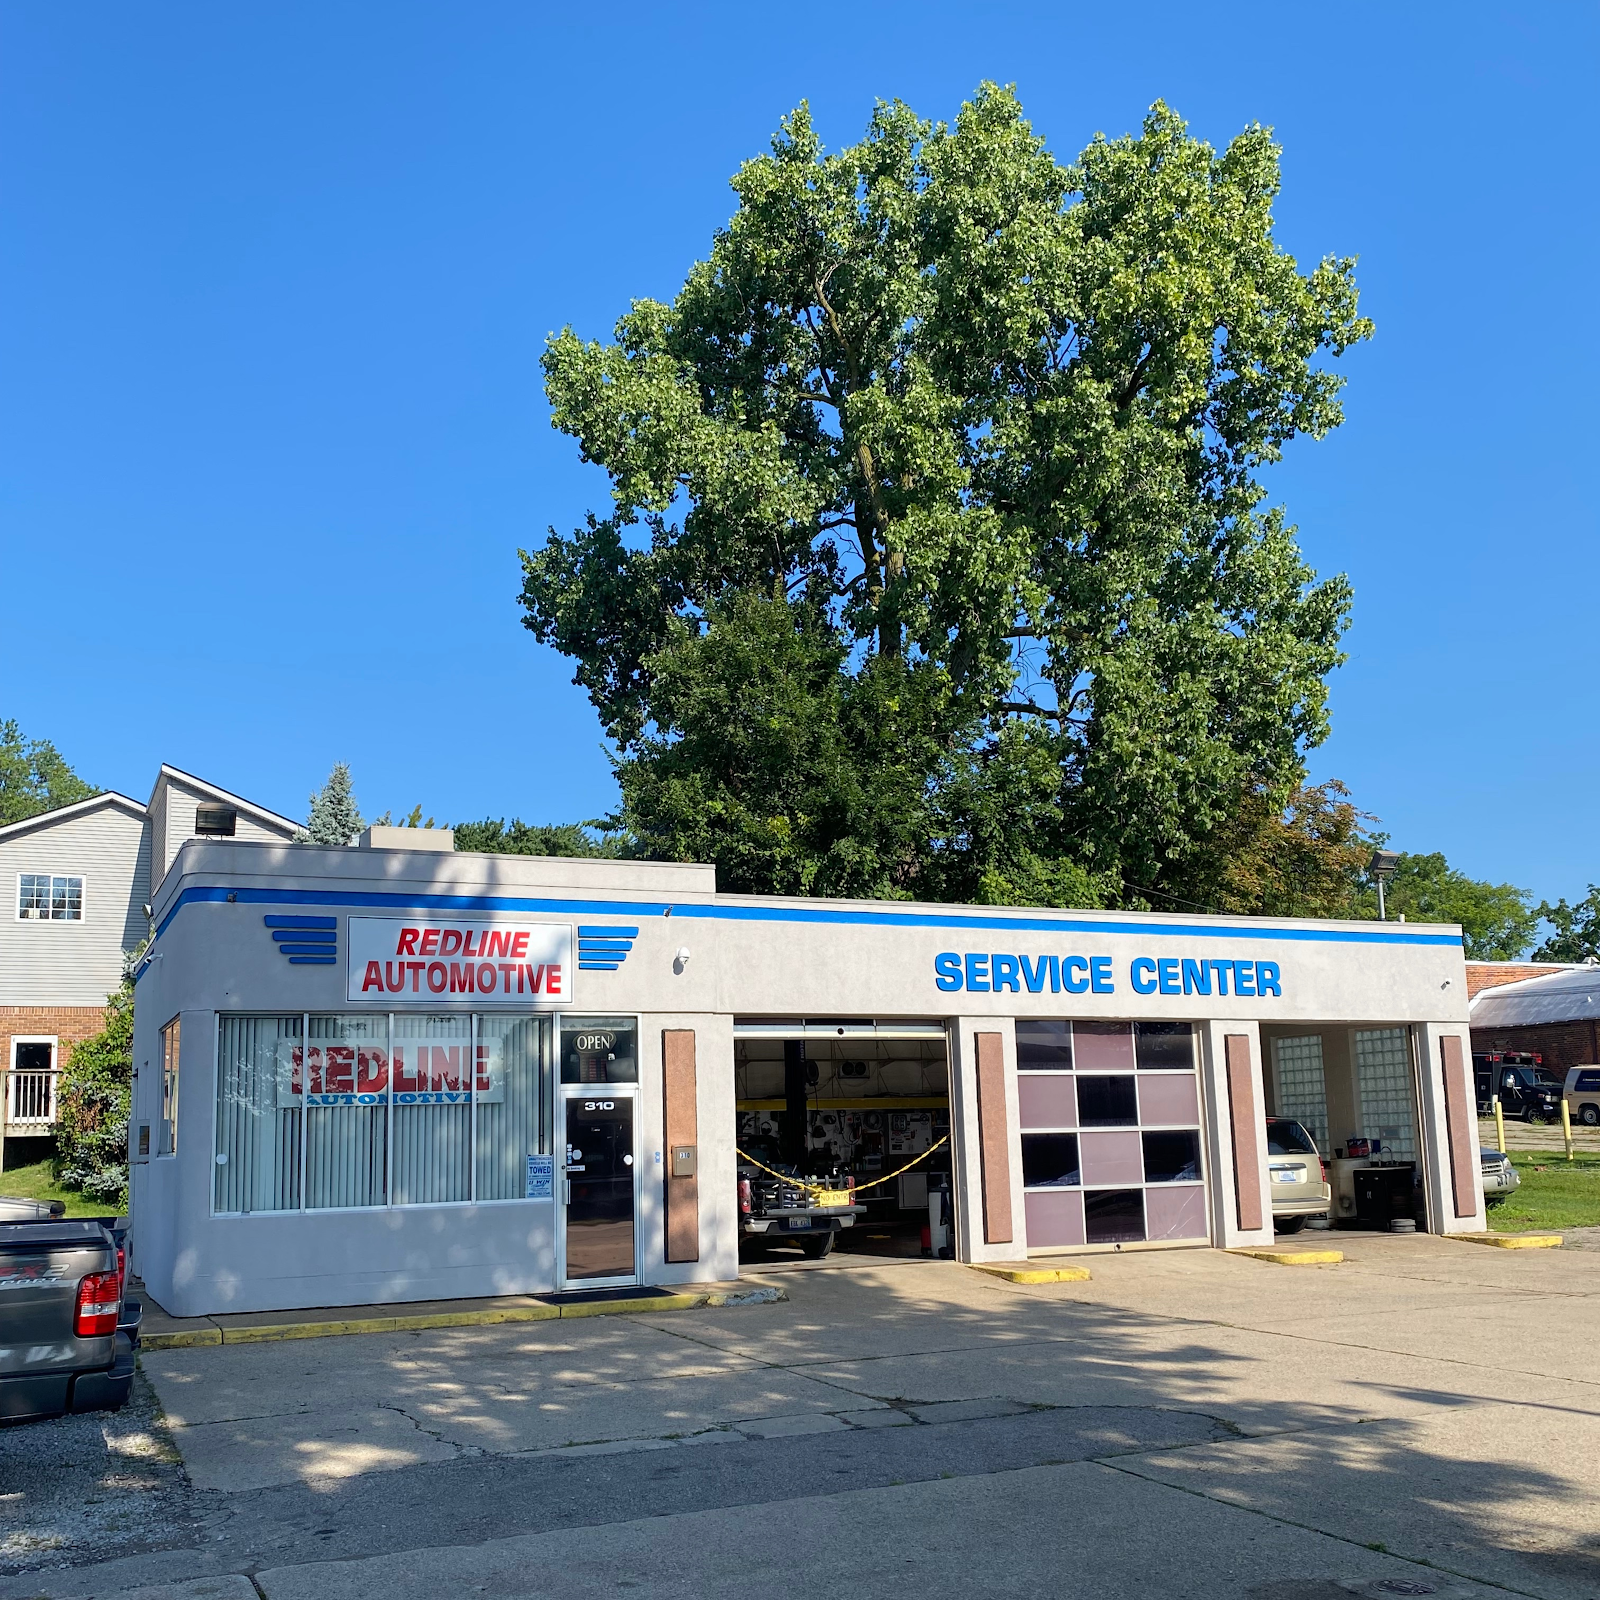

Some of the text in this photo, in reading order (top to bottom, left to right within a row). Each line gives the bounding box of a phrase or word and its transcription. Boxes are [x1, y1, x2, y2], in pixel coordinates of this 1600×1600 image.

[396, 927, 531, 958] REDLINE
[361, 960, 562, 994] AUTOMOTIVE
[934, 952, 1282, 997] SERVICE CENTER
[576, 1035, 611, 1050] OPEN
[291, 1046, 490, 1094] REDLINE
[306, 1092, 479, 1106] AUTOMOTIVE
[584, 1101, 615, 1111] 310
[529, 1166, 551, 1174] TOWED
